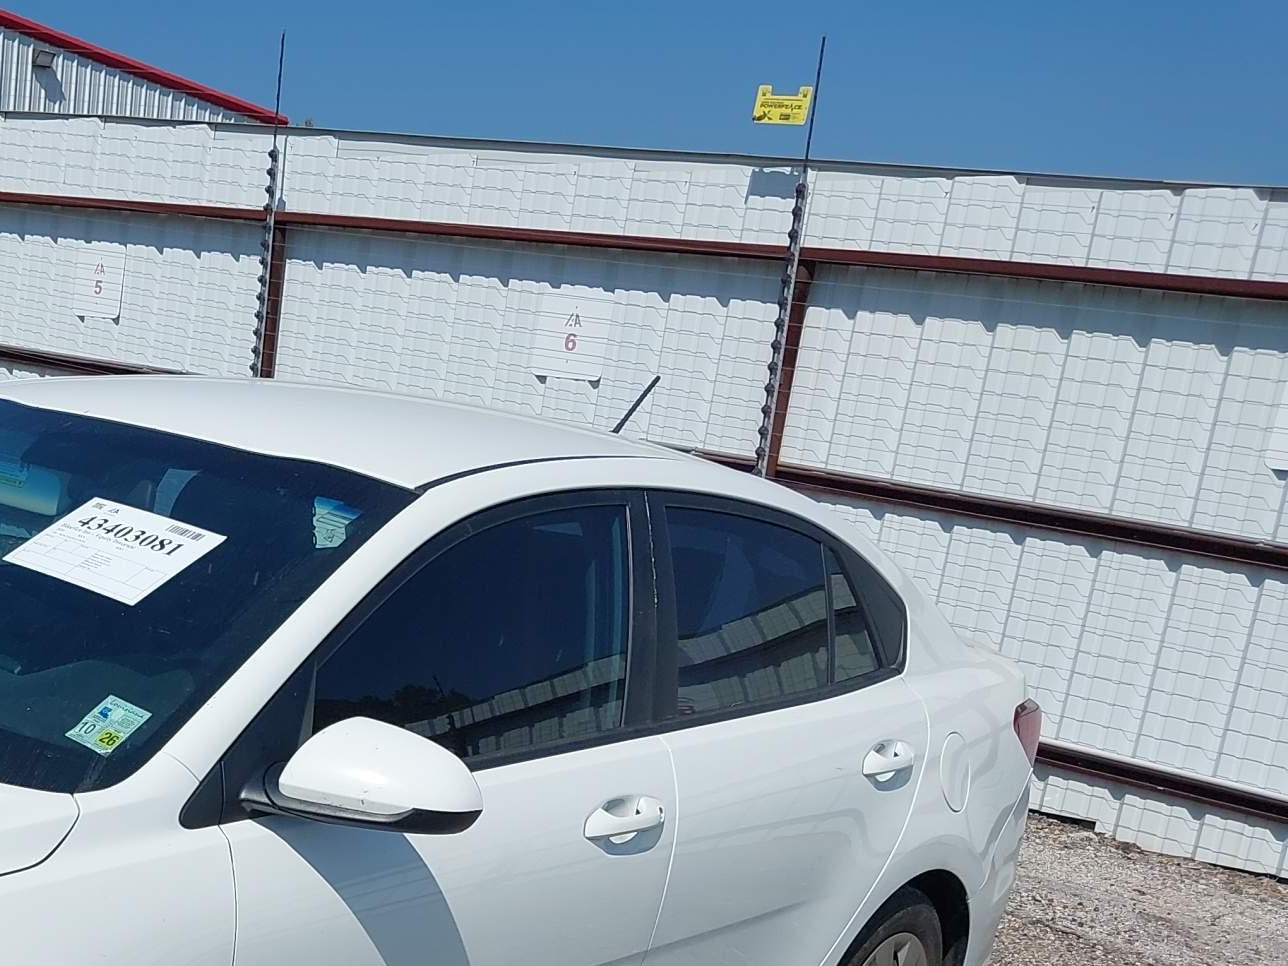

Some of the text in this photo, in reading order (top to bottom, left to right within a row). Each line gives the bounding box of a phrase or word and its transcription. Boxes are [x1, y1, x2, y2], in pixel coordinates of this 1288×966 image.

[94, 280, 103, 295] 5
[564, 333, 577, 352] 6
[78, 516, 185, 557] 43403081
[78, 721, 97, 735] 10
[98, 731, 120, 747] 26
